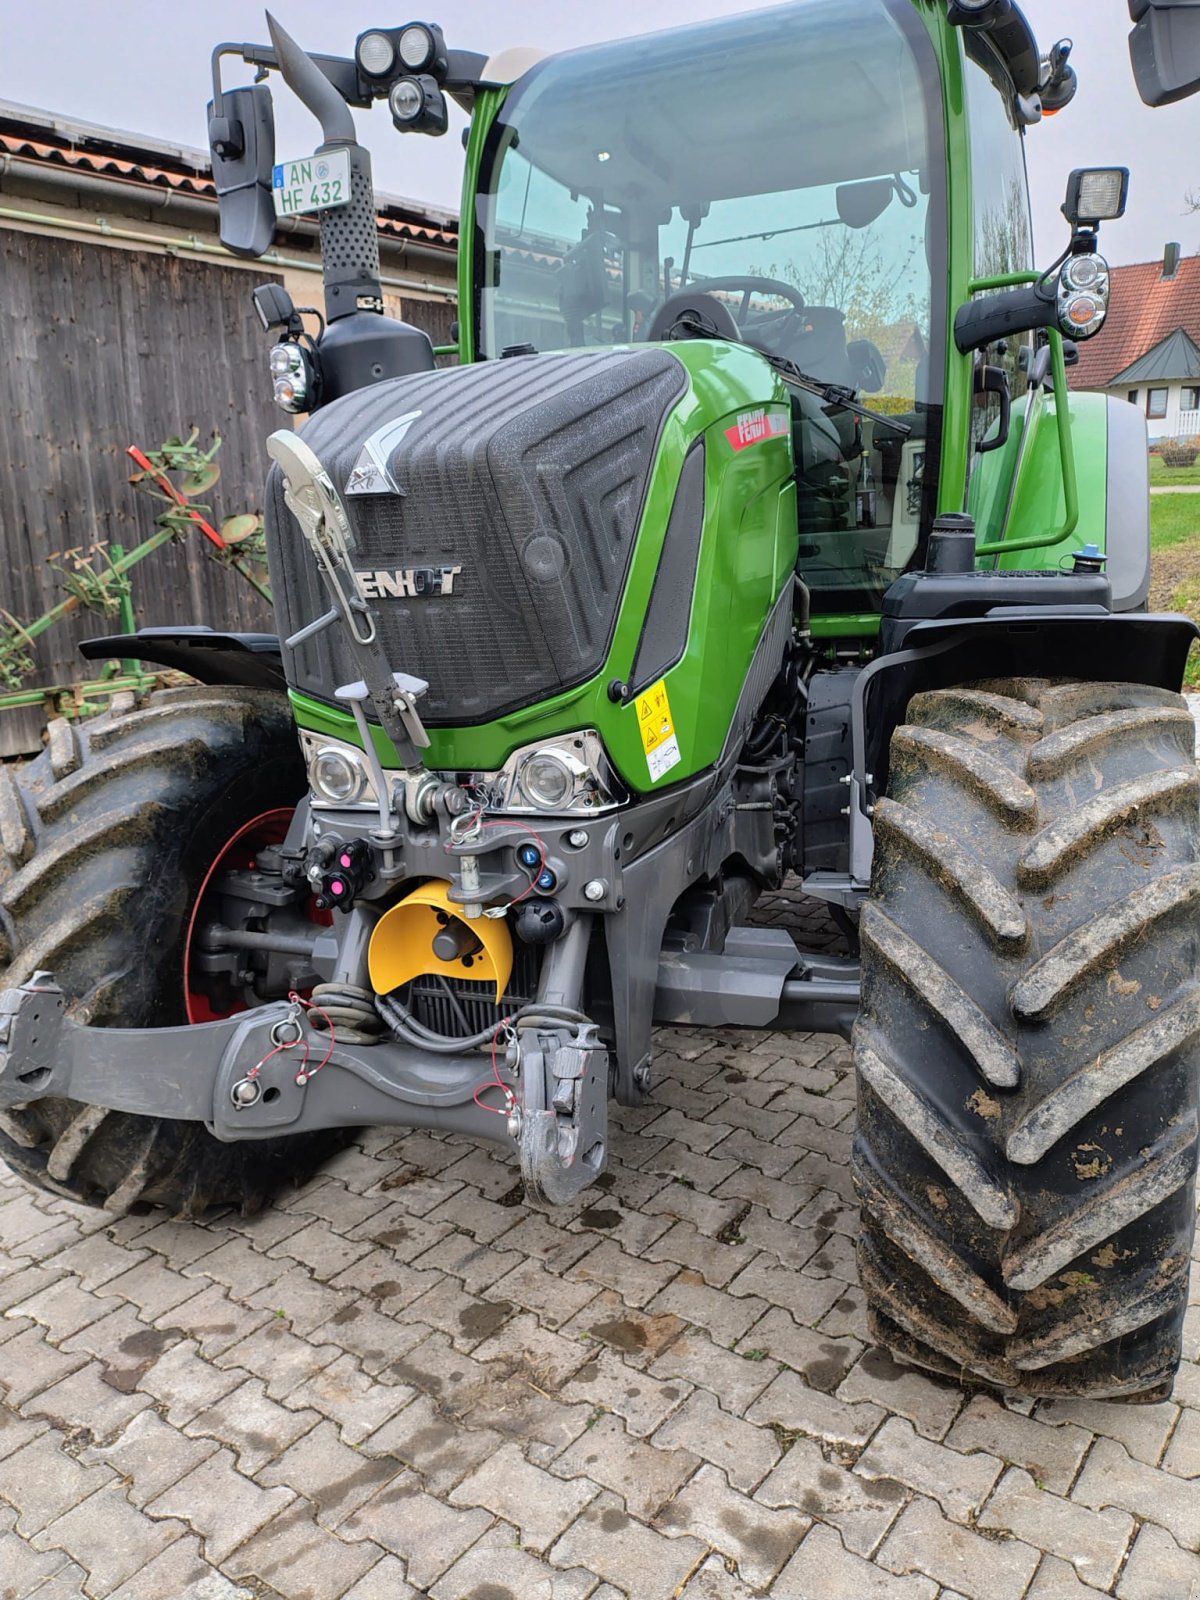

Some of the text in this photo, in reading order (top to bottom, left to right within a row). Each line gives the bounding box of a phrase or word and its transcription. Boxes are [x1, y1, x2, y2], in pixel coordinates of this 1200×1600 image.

[290, 161, 312, 186] AN
[281, 180, 342, 213] HF 432
